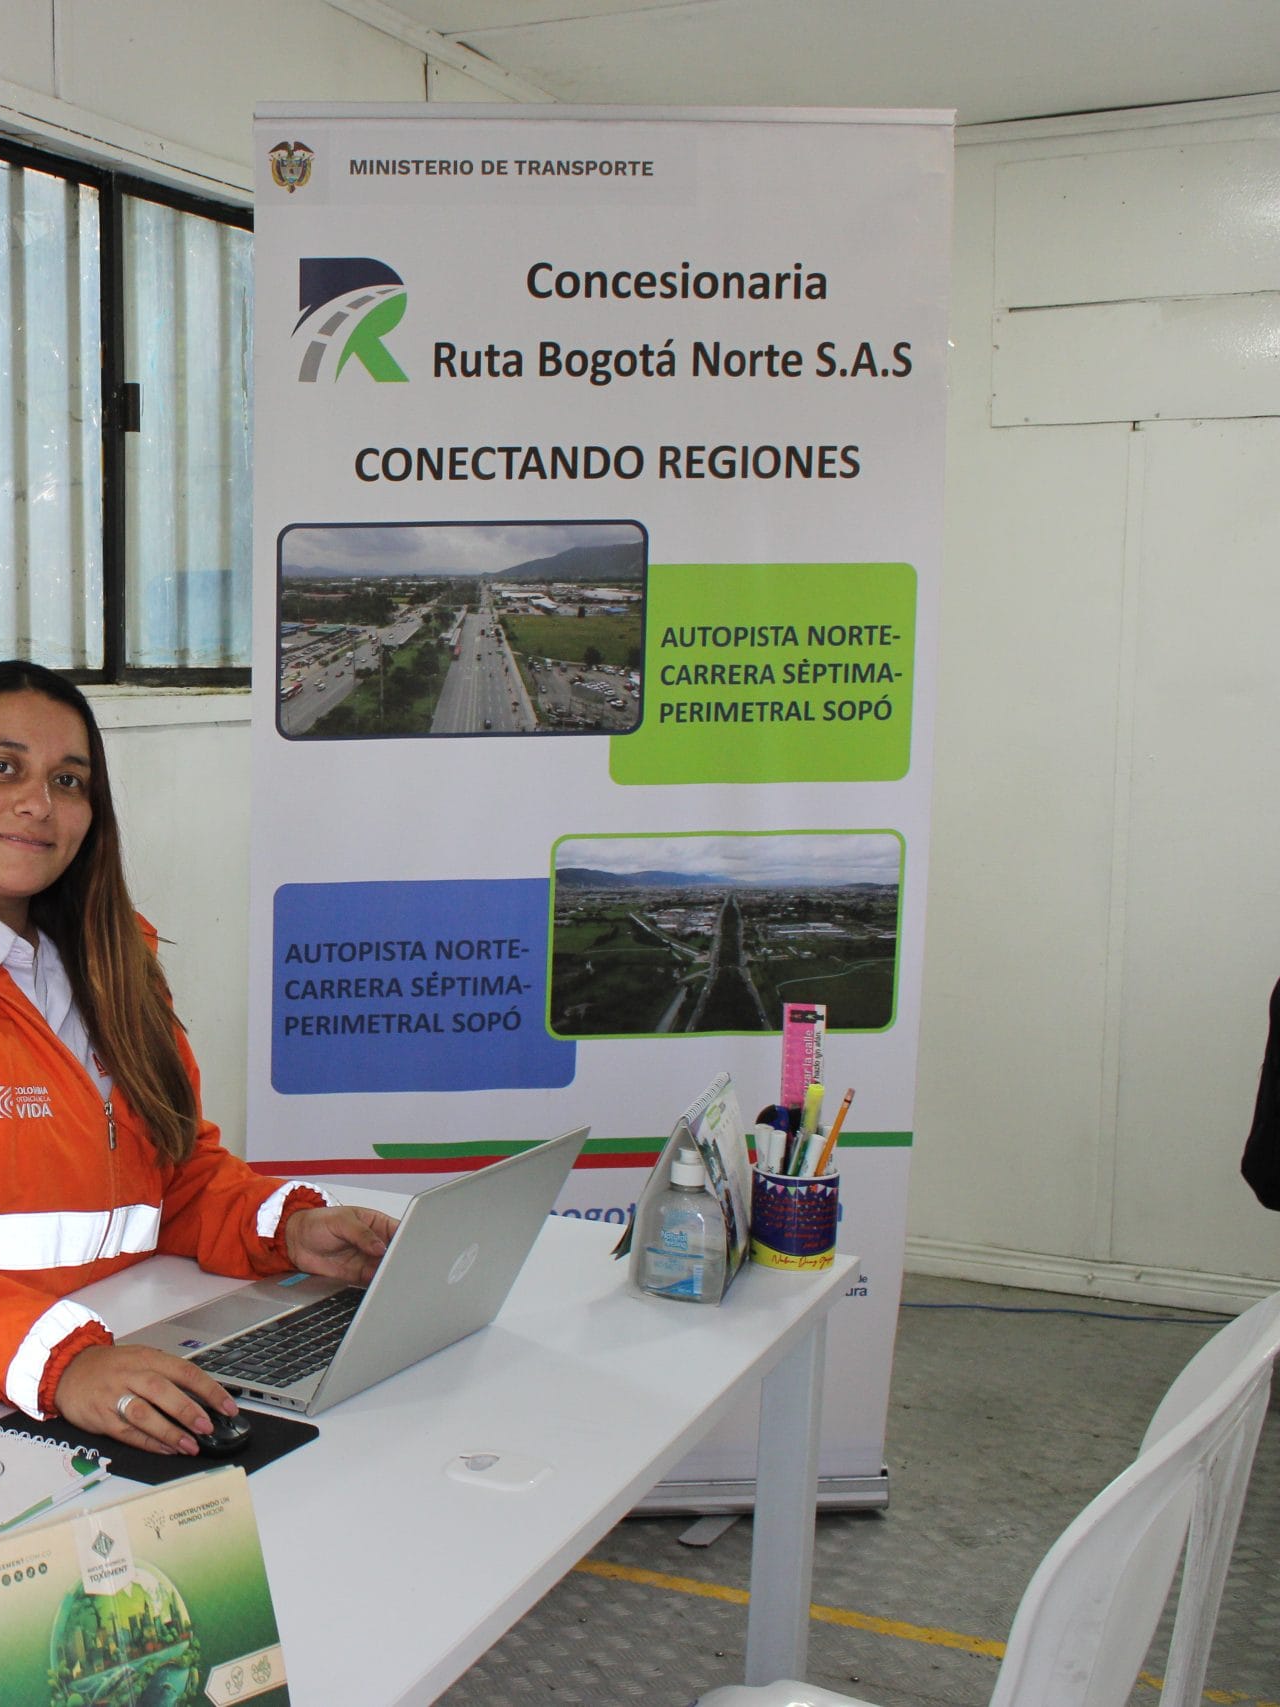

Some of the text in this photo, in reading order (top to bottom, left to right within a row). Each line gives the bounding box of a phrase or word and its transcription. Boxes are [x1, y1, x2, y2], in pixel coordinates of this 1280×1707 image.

[349, 158, 654, 177] MINISTERIO DE TRANSPORTE
[526, 261, 828, 300] Concesionaria
[433, 339, 913, 386] Ruta Bogotá Norte S.A.S
[354, 444, 861, 482] CONECTANDO REGIONES
[661, 625, 901, 648] AUTOPISTA NORTE-
[660, 664, 775, 685] CARRERA
[660, 694, 892, 723] PERIMETRAL SOPÓ
[285, 939, 529, 964] AUTOPISTA NORTE-
[285, 977, 403, 1000] CARRERA
[285, 1005, 521, 1036] PERIMETRAL SOPÓ
[16, 1103, 53, 1119] VIDA
